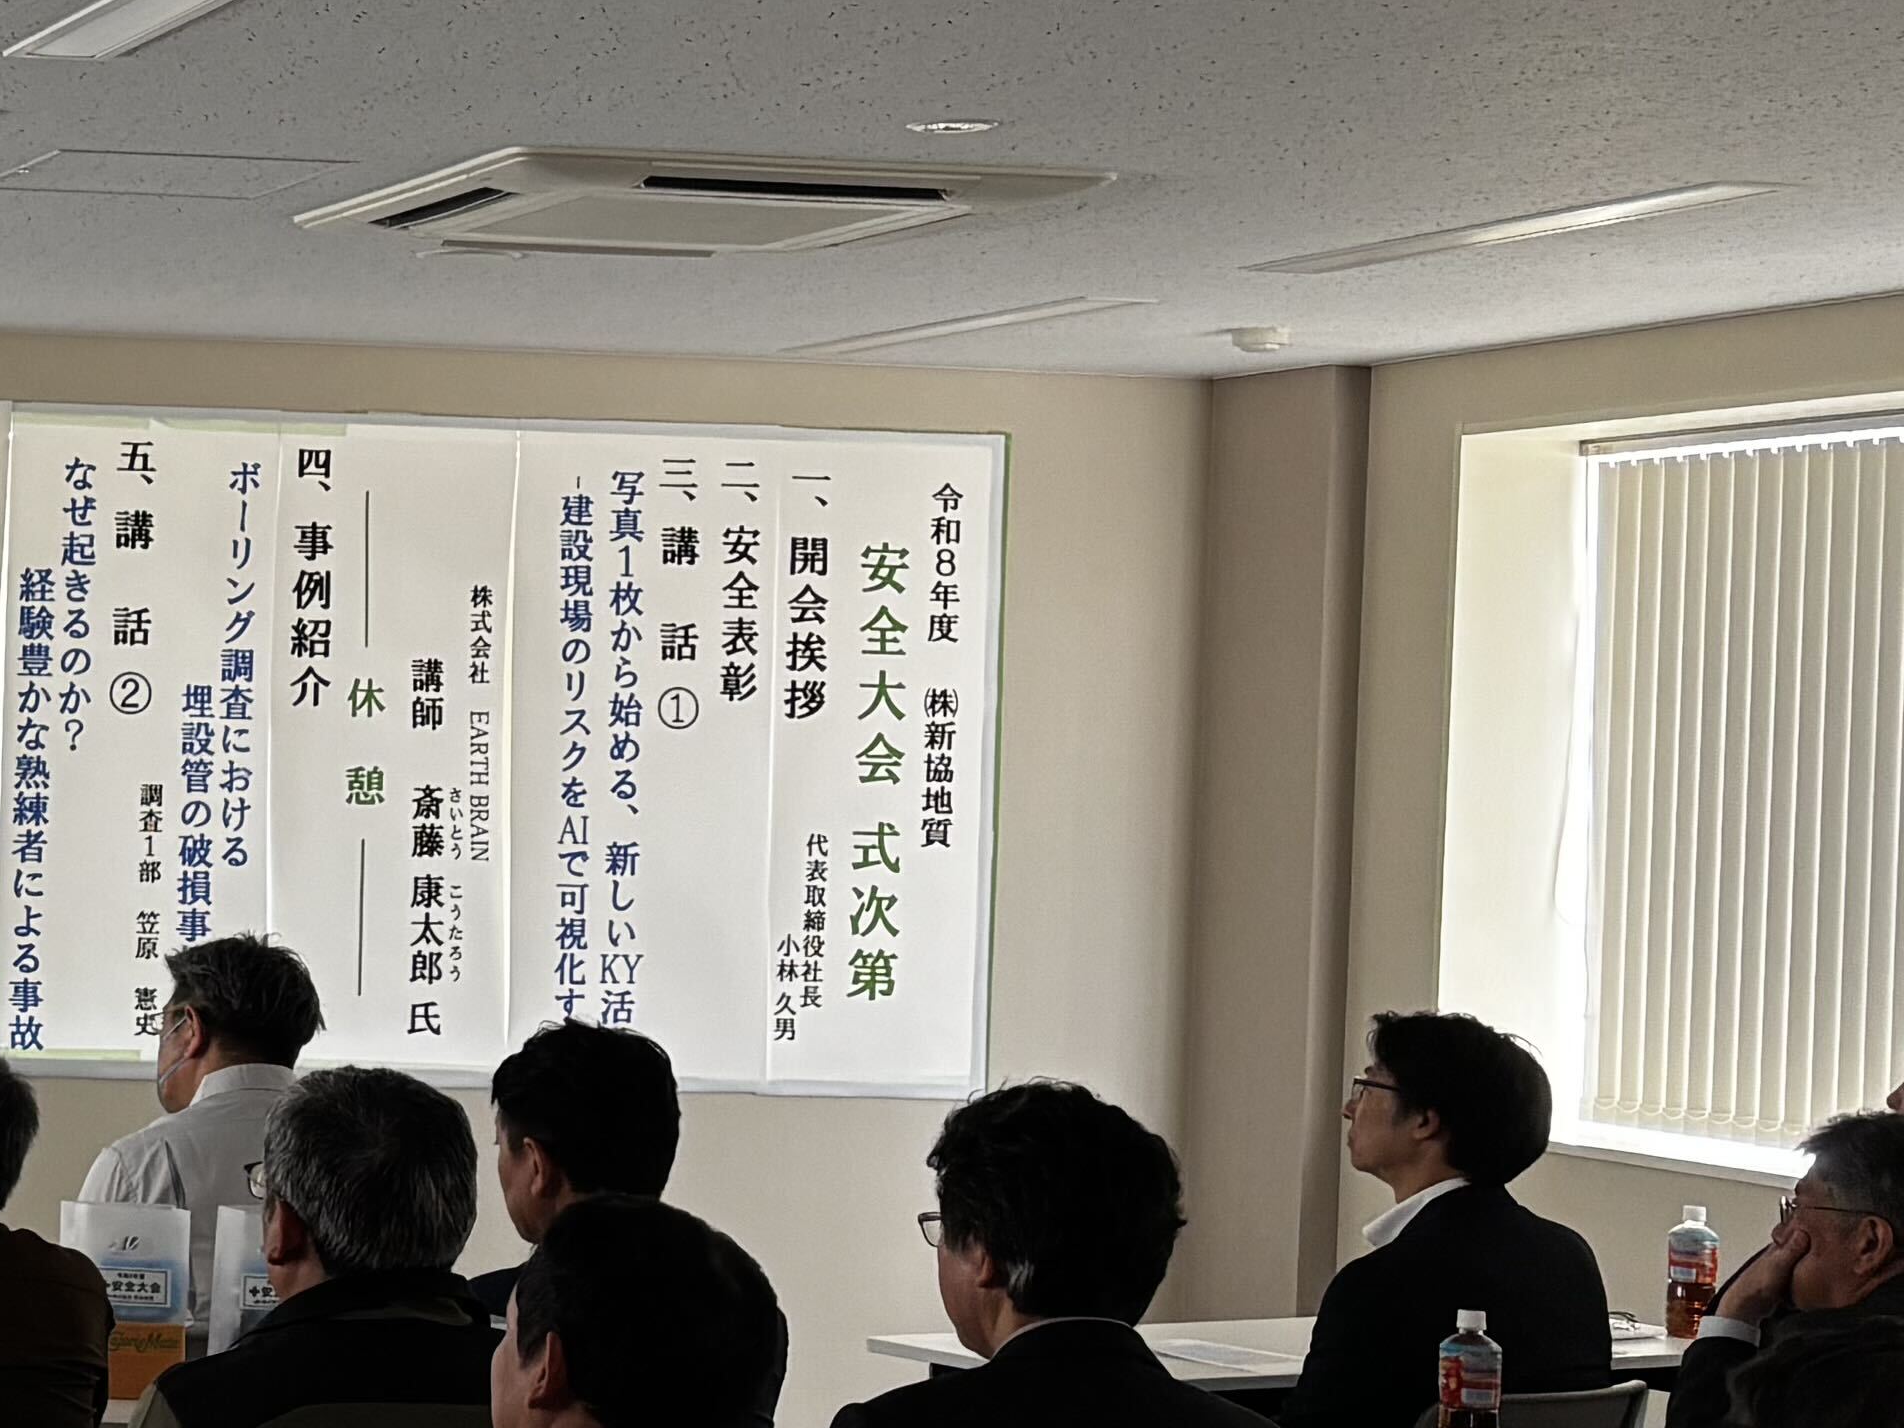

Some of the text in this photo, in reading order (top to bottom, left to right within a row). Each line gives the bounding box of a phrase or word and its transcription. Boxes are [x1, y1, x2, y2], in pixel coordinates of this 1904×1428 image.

[58, 456, 97, 752] なぜ起きるのか？
[219, 461, 262, 867] ボーリング調査における
[290, 448, 334, 707] 四、事例紹介
[719, 461, 761, 702] 二、安全表彰
[783, 475, 831, 720] 一、開会挨拶
[927, 482, 964, 643] 令和8年度
[8, 566, 56, 1051] 経験豊かな熟練者による事故
[138, 783, 164, 884] 調査1部
[176, 684, 215, 948] 埋設管の破損事
[345, 677, 386, 806] 休憩
[407, 657, 445, 1036] 講師 斎藤 康太郎 氏
[468, 584, 493, 862] 株式会社 EARTH BRAIN
[599, 470, 646, 1025] 写真1枚から始める、新しいKY活
[846, 541, 910, 1001] 安全大会 式次第
[134, 910, 161, 960] 笠原
[448, 787, 464, 983] さいとう こうたろう
[773, 933, 801, 1041] 小林 久男
[799, 833, 829, 1008] 代表取締役社長
